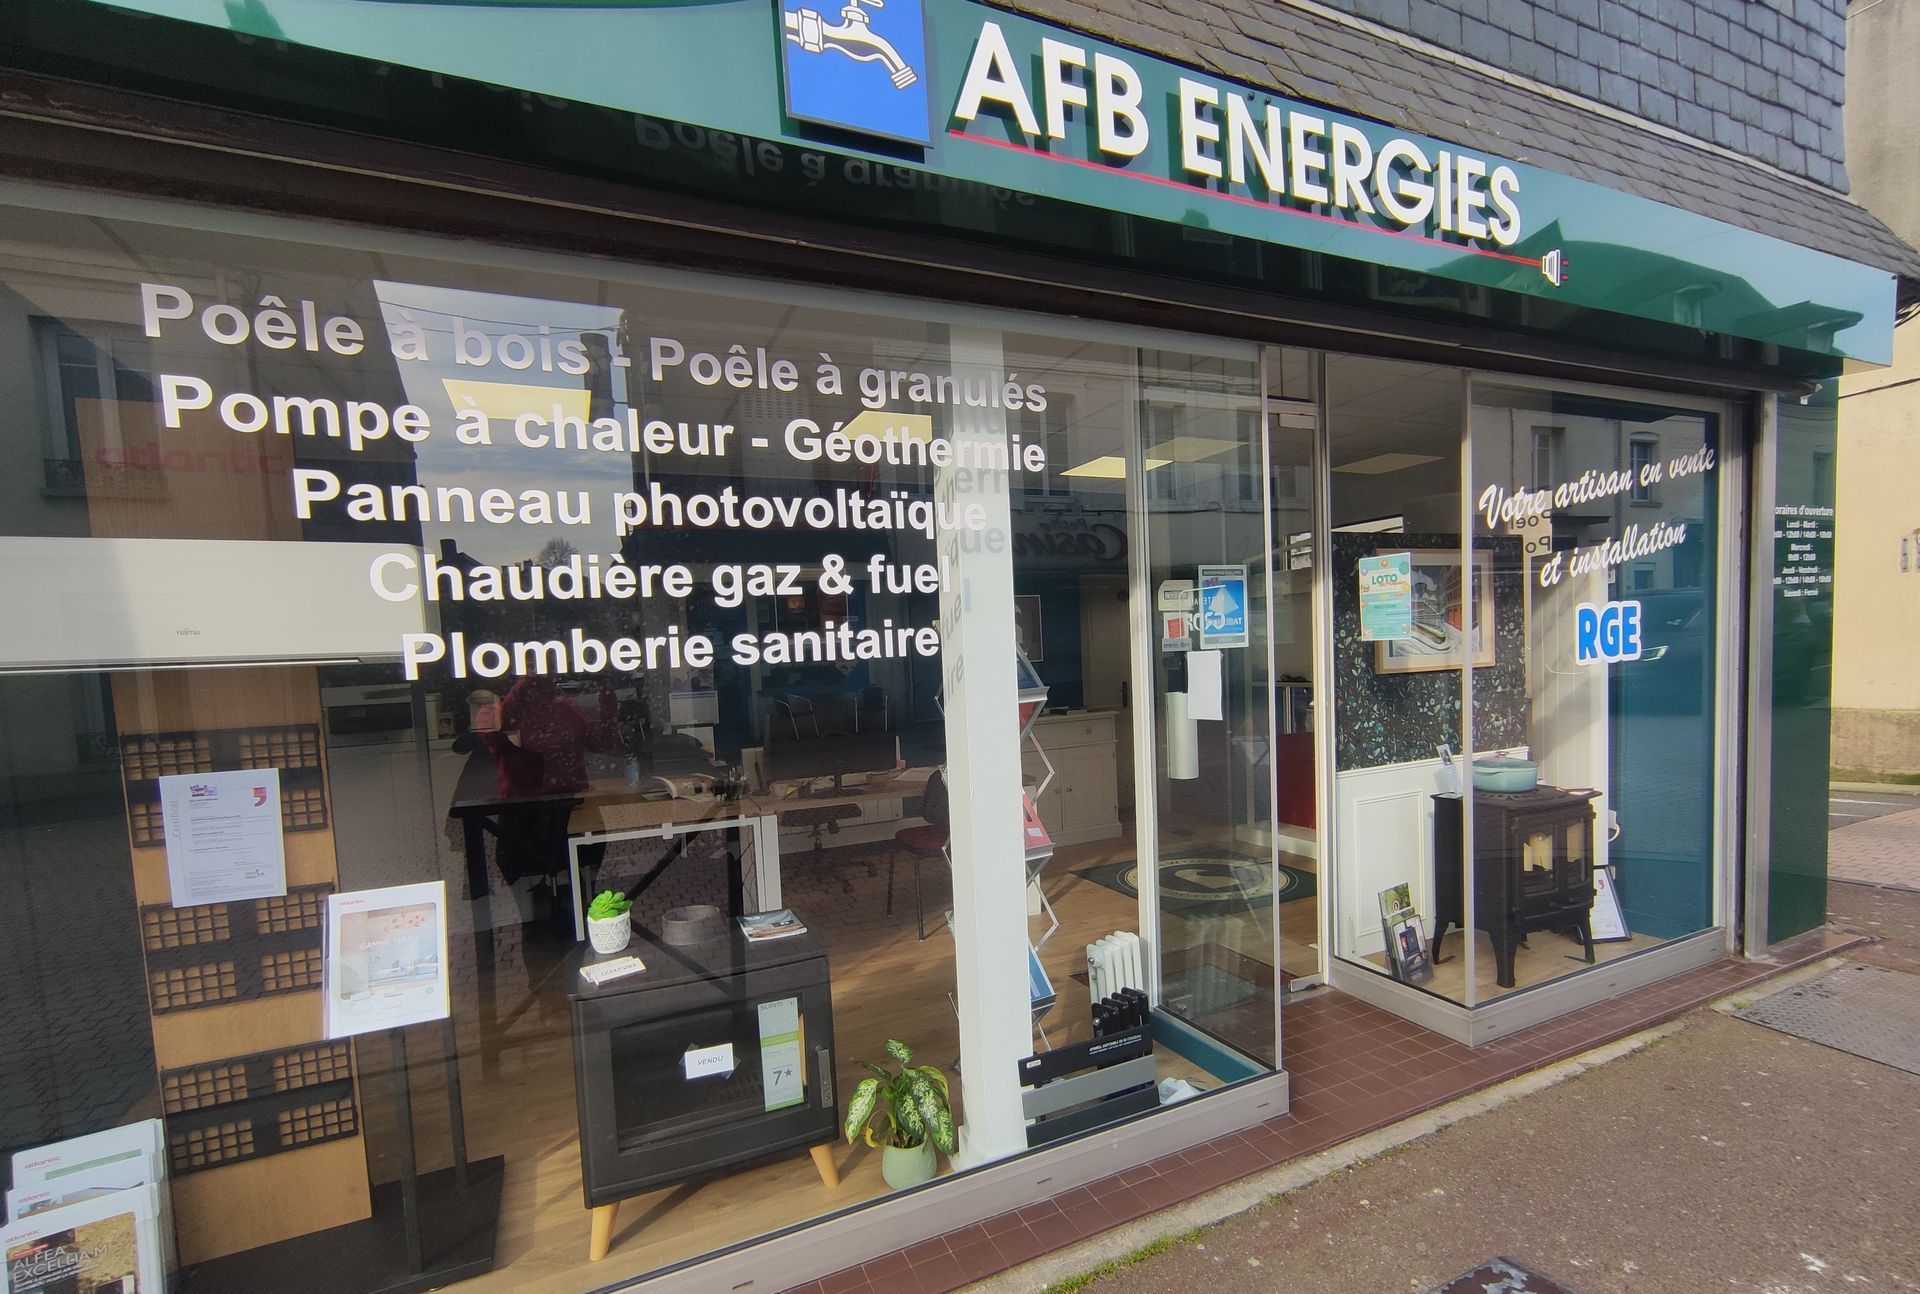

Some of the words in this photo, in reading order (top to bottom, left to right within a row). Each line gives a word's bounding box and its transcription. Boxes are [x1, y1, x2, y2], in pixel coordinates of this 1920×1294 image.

[955, 20, 1150, 158] AFB
[1179, 76, 1522, 247] ENERGIES
[141, 282, 365, 355] Poêle
[390, 318, 428, 362] à
[453, 317, 591, 375] bois
[649, 338, 799, 392] Poêle
[816, 352, 843, 396] à
[858, 367, 1048, 413] granulés
[160, 374, 431, 451] Pompe
[454, 396, 492, 446] à
[514, 403, 734, 457] chaleur
[784, 418, 1046, 473] Géothermie
[292, 467, 592, 525] Panneau
[612, 481, 988, 540] photovoltaïque
[1478, 483, 1547, 530] Votre
[1554, 469, 1634, 512] artisan
[1640, 462, 1662, 488] en
[1668, 442, 1716, 482] vente
[1775, 504, 1798, 515] oraires
[369, 551, 693, 603] Chaudière
[712, 561, 803, 608] gaz
[818, 553, 855, 596] &
[867, 553, 951, 597] fuel
[1371, 573, 1398, 585] LOTO
[1539, 552, 1563, 588] et
[1569, 521, 1687, 579] installation
[401, 625, 714, 681] Plomberie
[731, 618, 940, 666] sanitaire
[1576, 603, 1641, 665] RGE
[696, 1054, 724, 1067] VENDU
